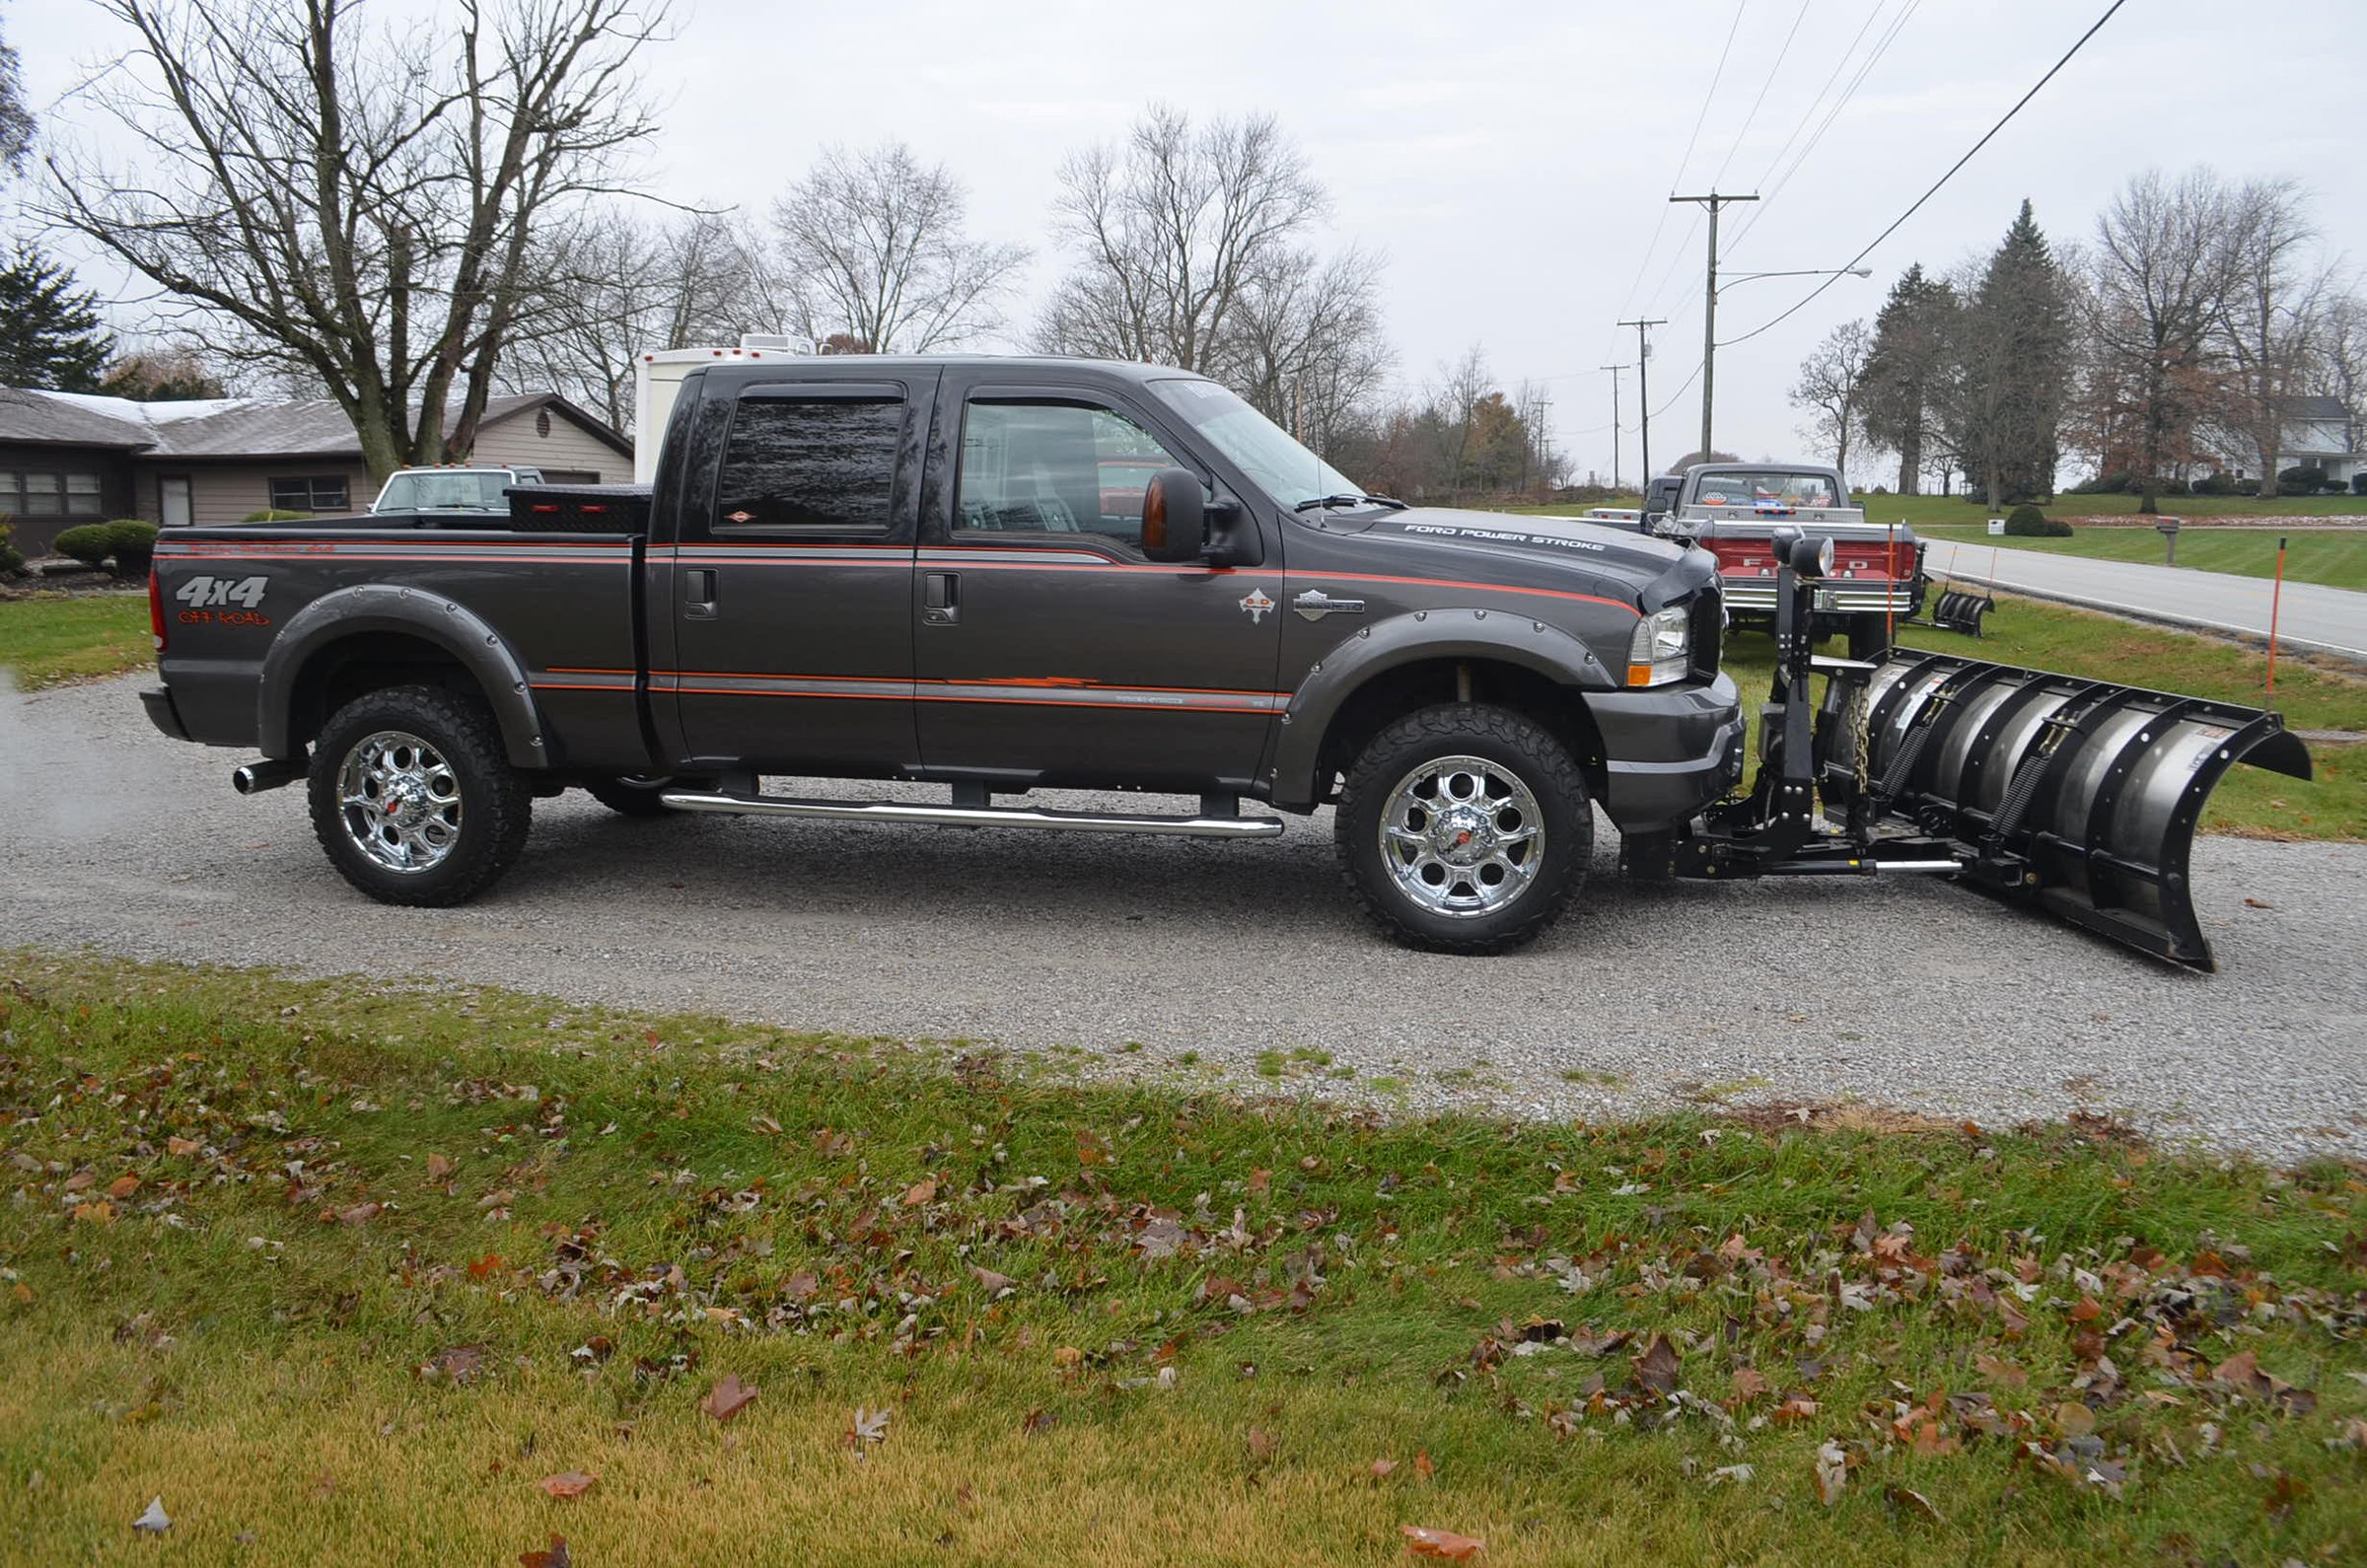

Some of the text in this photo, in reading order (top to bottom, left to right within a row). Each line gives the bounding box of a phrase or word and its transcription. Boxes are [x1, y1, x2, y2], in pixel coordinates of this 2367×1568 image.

[1403, 524, 1607, 552] FORD POWER STROKE
[1743, 558, 1868, 570] FD
[176, 576, 269, 608] 4x4
